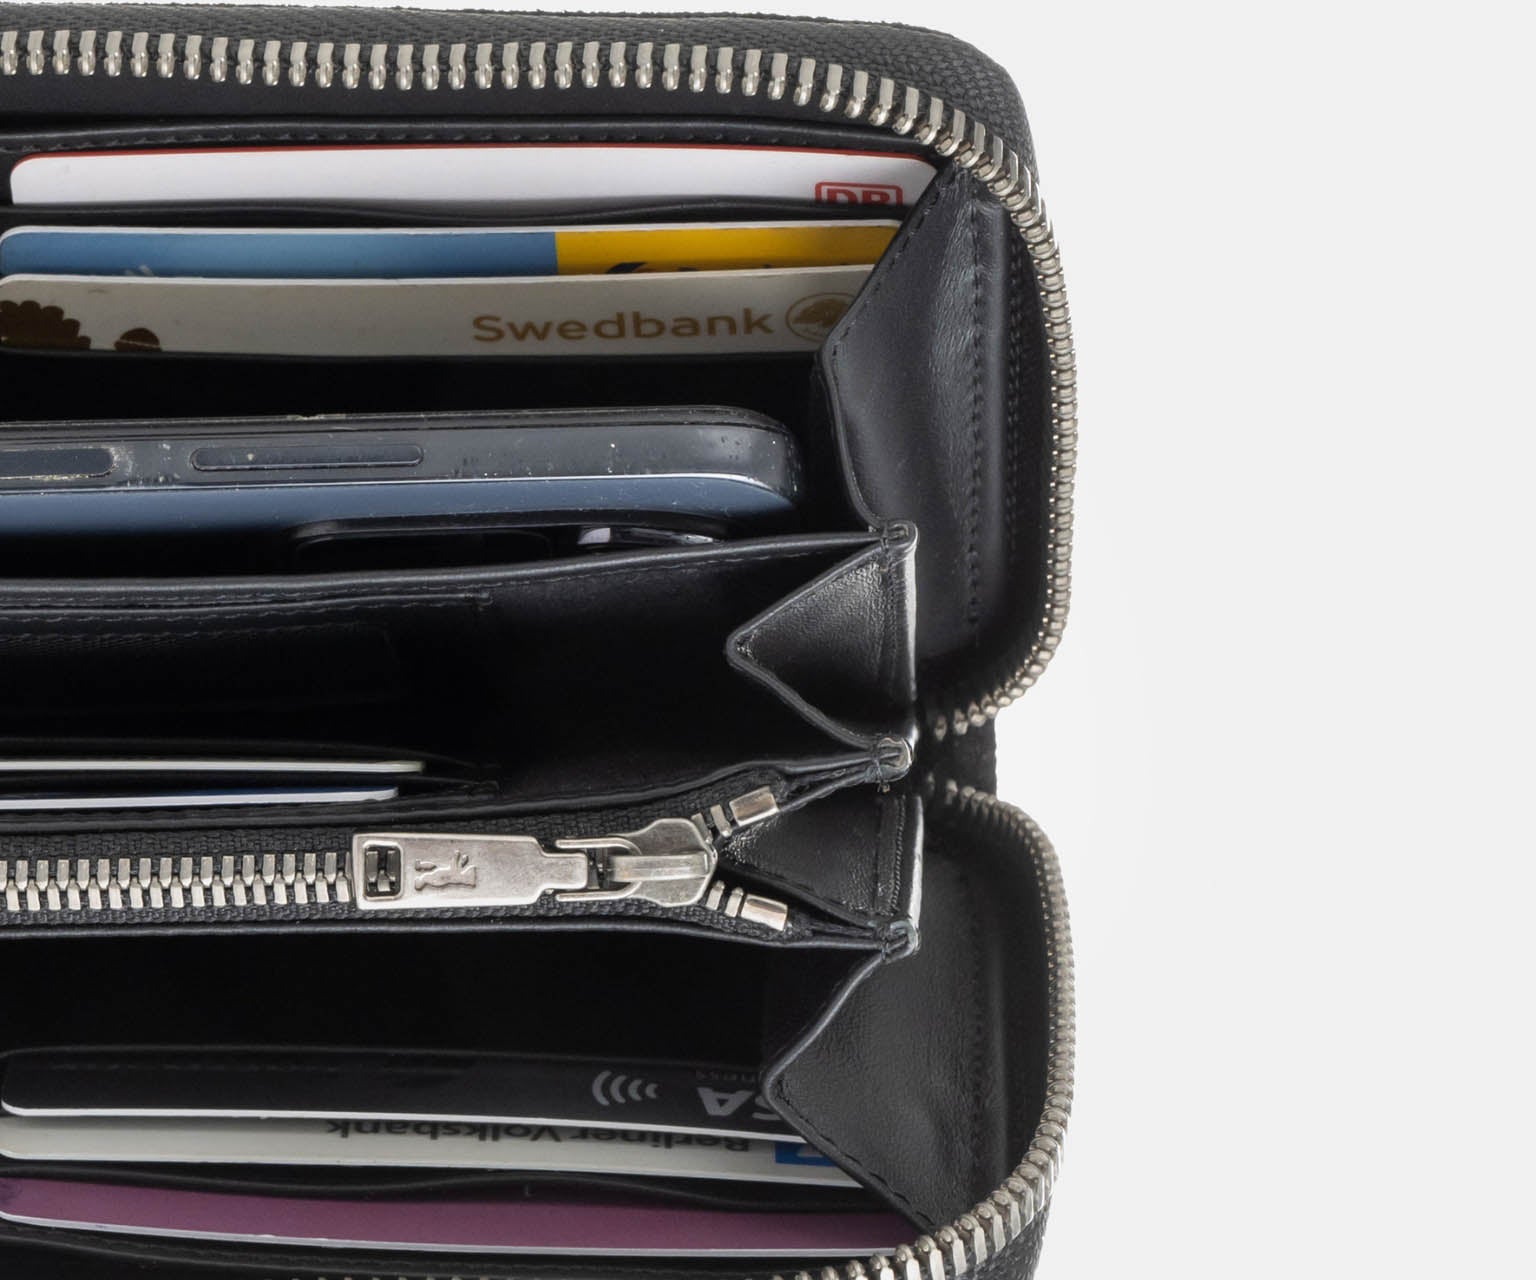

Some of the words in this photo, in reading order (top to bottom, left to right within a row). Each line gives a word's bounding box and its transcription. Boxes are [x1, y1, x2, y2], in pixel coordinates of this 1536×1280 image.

[473, 308, 775, 343] Swedbank
[326, 1120, 562, 1142] Volksbank
[569, 1128, 750, 1152] Berliner
